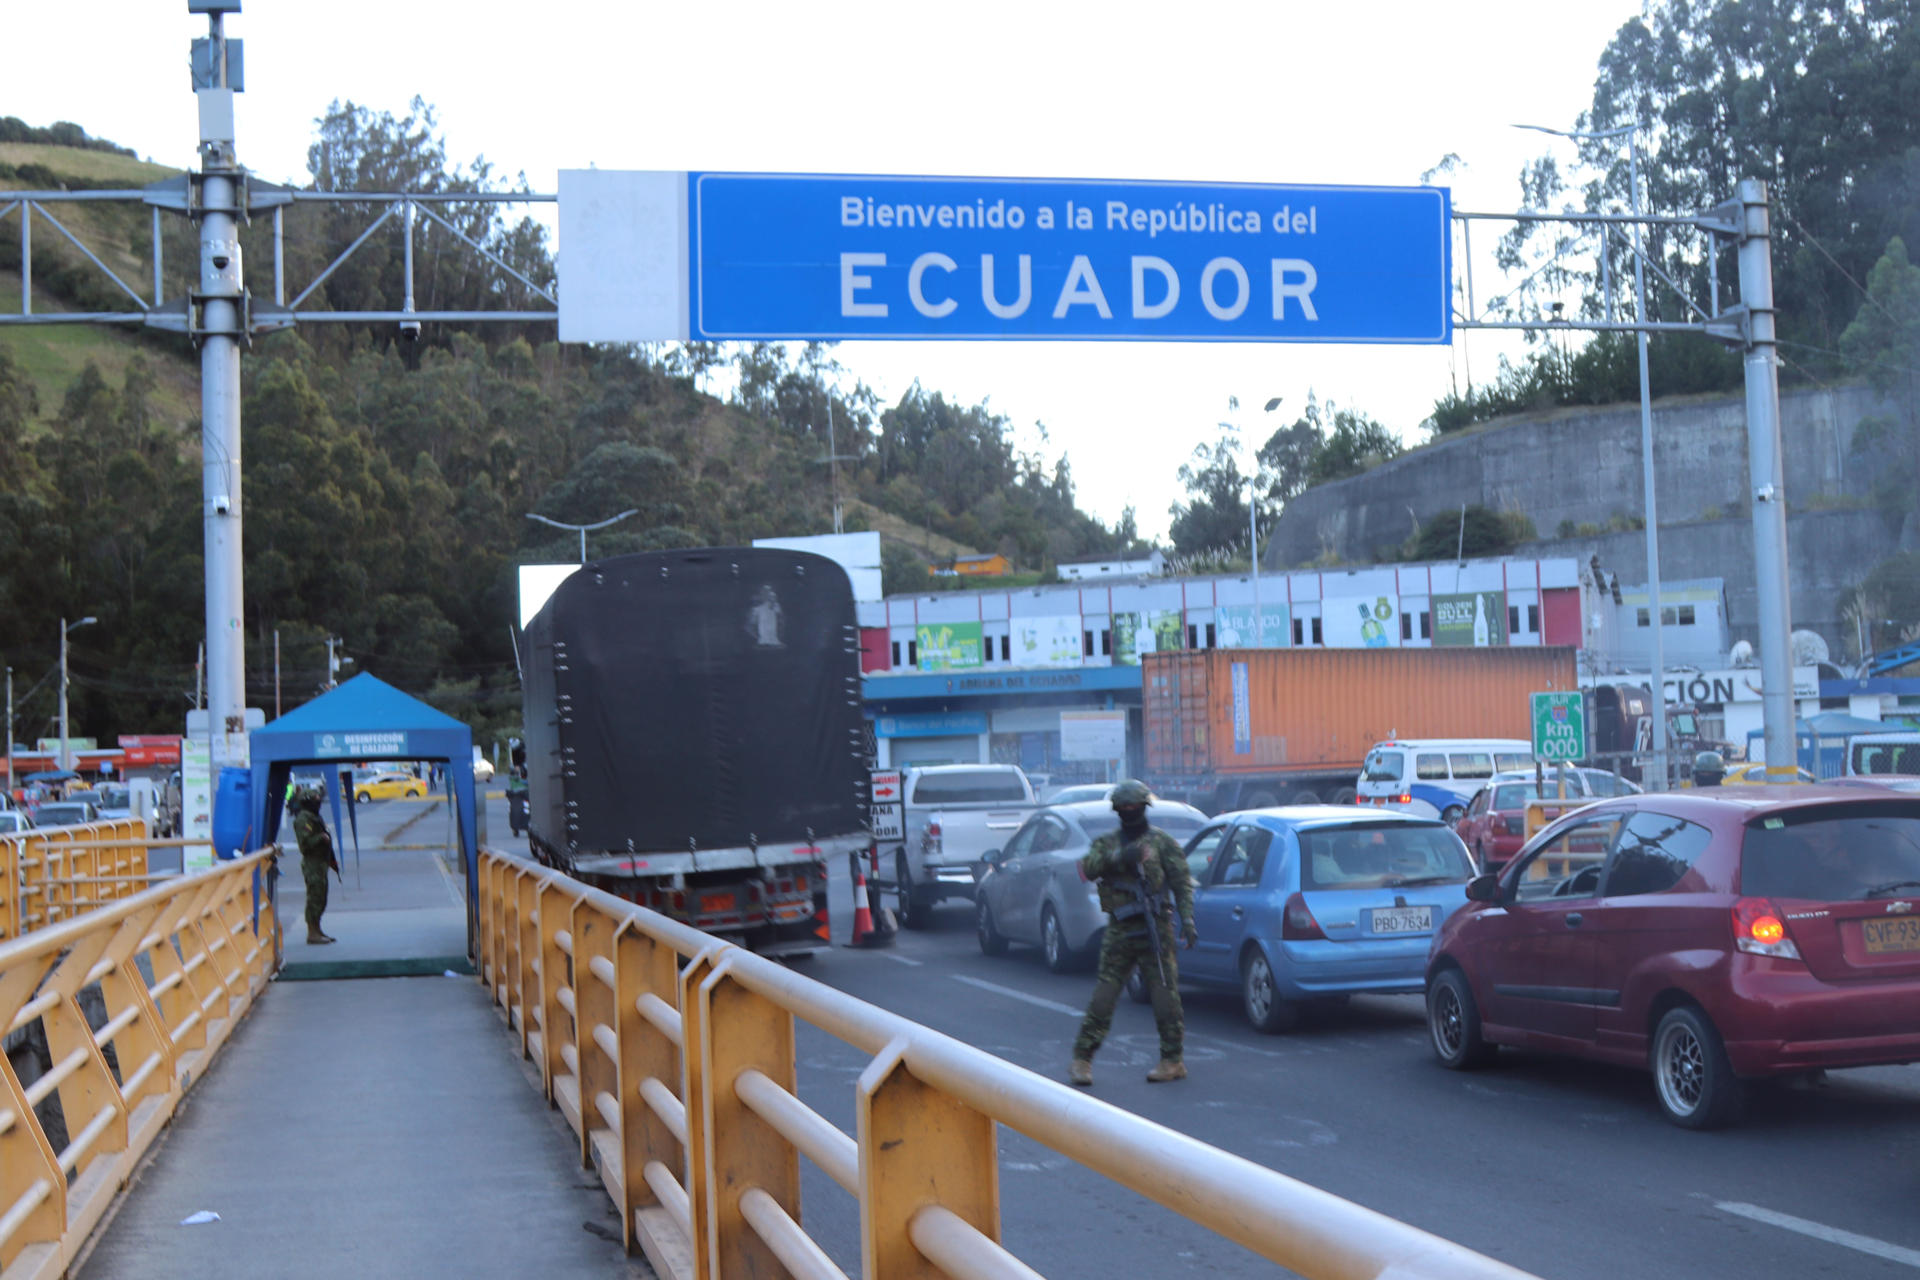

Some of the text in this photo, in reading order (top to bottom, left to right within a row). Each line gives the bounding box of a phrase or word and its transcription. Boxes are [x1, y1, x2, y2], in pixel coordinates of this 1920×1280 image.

[841, 196, 1318, 239] Bienvenido a la República del
[840, 252, 1319, 321] ECUADOR
[1232, 614, 1280, 630] BLACO
[1546, 722, 1574, 737] km
[344, 732, 404, 744] DESINFECCIÓN
[362, 743, 399, 753] CALZADO
[1543, 739, 1578, 757] 000
[871, 805, 894, 816] ANA
[875, 825, 898, 837] DOR
